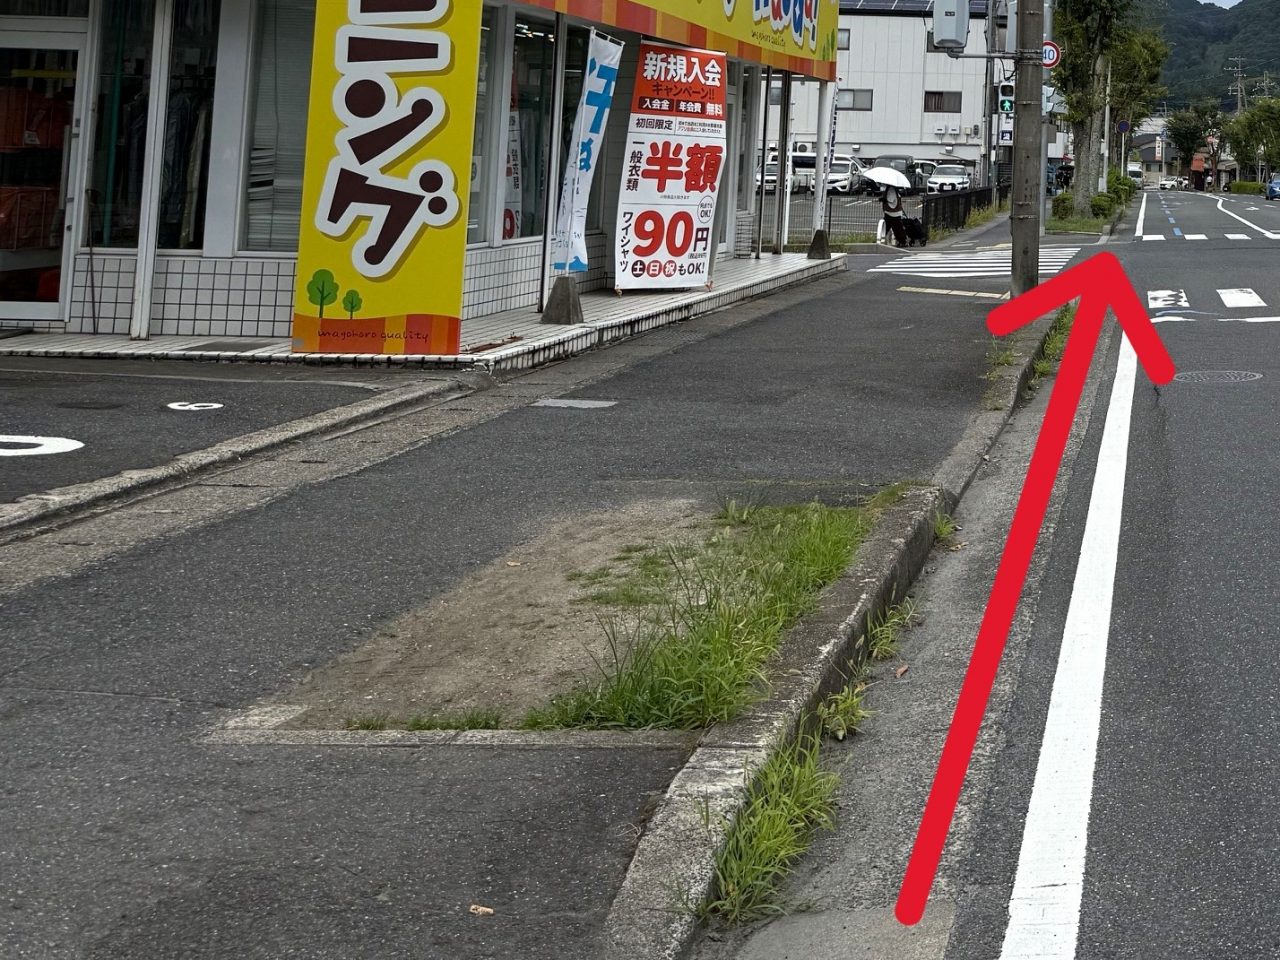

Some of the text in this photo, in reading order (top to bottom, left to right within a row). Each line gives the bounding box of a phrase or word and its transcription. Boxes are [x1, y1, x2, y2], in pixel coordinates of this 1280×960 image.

[643, 51, 722, 87] 新規入会
[652, 82, 715, 100] キャンペーン!!
[642, 98, 722, 116] 入会金 年会費 無料
[635, 117, 674, 131] 初回限定
[625, 141, 645, 192] 一般衣類
[641, 140, 723, 192] 半額
[700, 209, 712, 218] OK!
[620, 211, 634, 273] ワイシャツ
[632, 261, 705, 277] 土日祝もOK!
